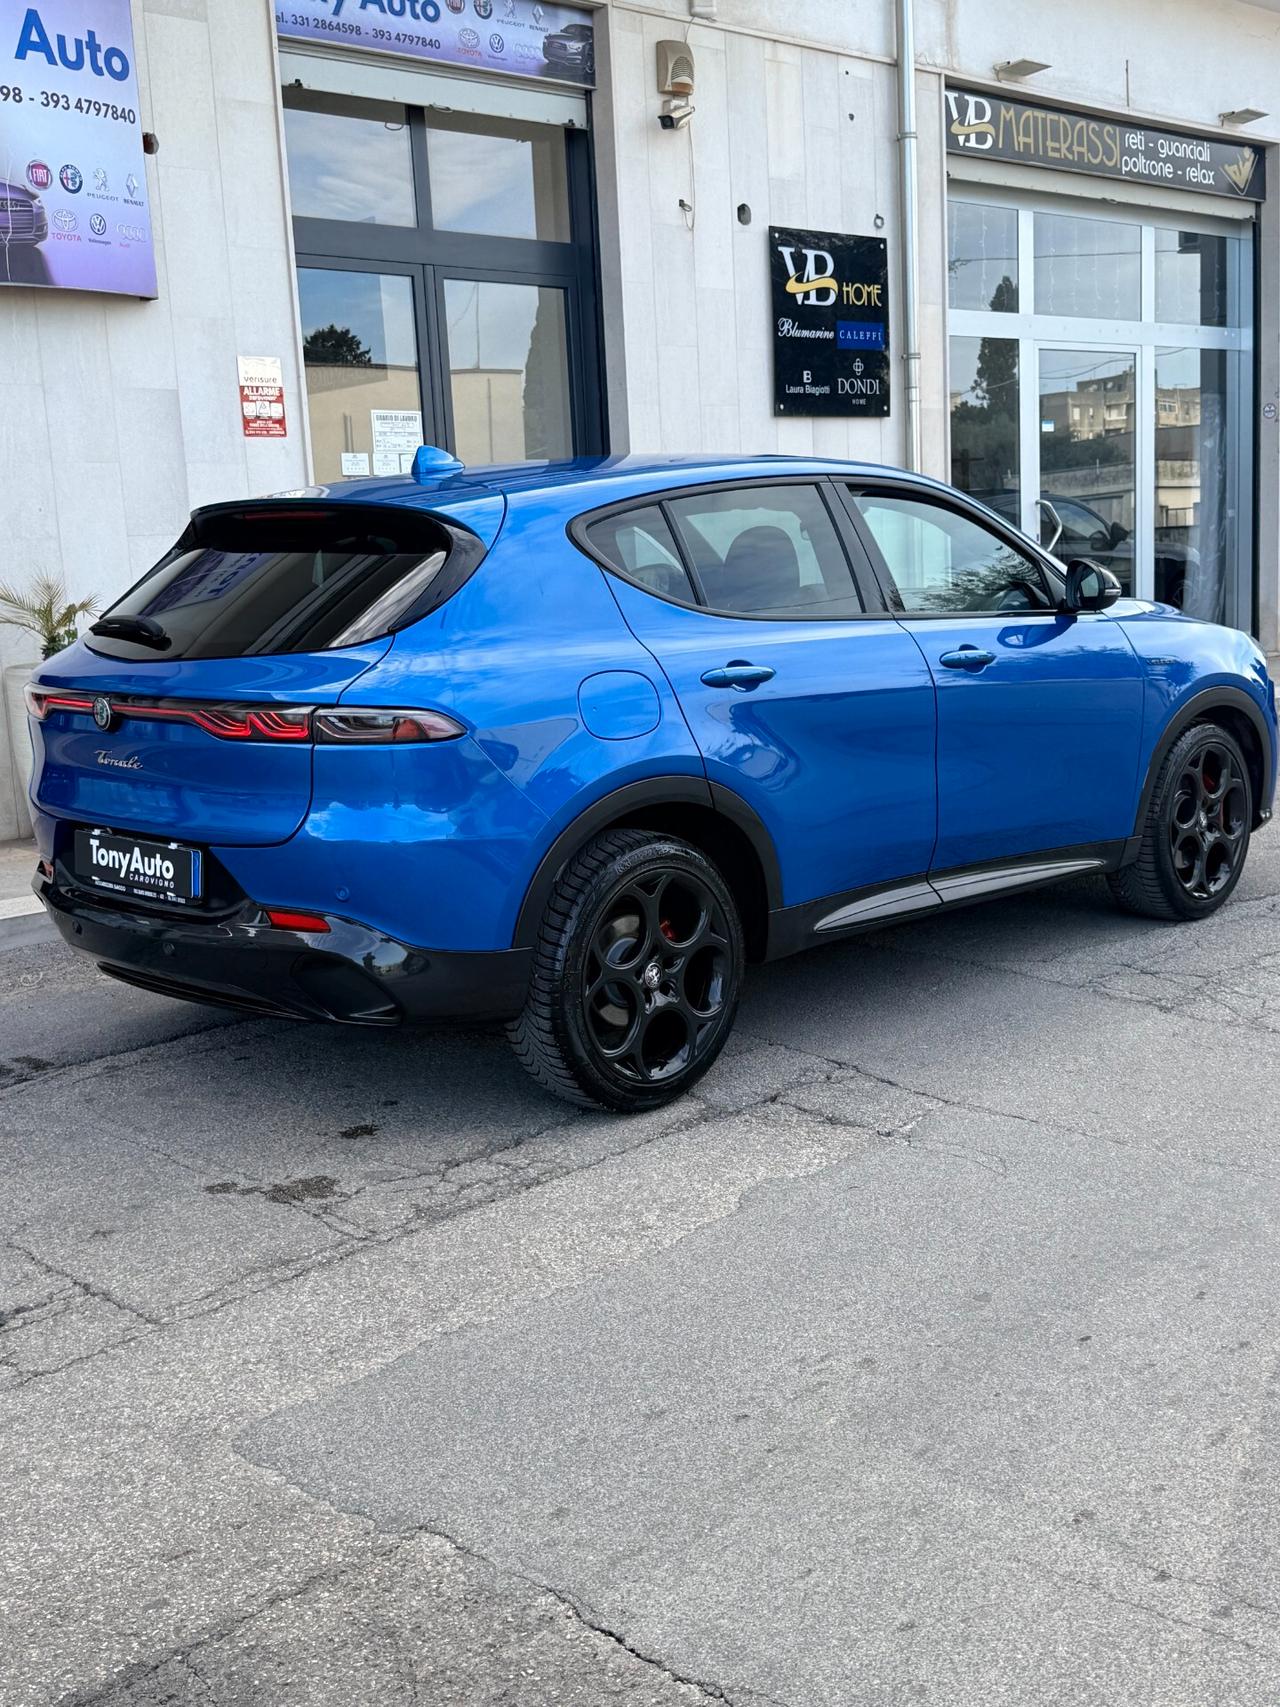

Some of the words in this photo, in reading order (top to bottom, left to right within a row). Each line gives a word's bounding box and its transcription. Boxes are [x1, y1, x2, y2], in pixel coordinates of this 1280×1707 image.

[291, 14, 311, 27] 331
[313, 18, 362, 36] 2864598
[372, 28, 392, 41] 393
[395, 32, 441, 49] 4797840
[15, 8, 130, 82] Auto
[0, 85, 23, 104] 98
[40, 91, 70, 111] 393
[74, 97, 136, 125] 4797840
[945, 91, 994, 150] VB
[999, 107, 1120, 168] MATERASSI
[1124, 131, 1145, 150] reti
[1158, 139, 1210, 163] guanciali
[32, 168, 48, 183] FIAT
[1122, 155, 1173, 184] poltrone
[1186, 162, 1215, 185] relax
[51, 232, 82, 242] TOYOTA
[778, 246, 837, 306] VB
[843, 282, 882, 307] HOME
[778, 317, 834, 340] Blumarine
[840, 329, 881, 341] CALEFFI
[803, 371, 812, 383] B
[838, 378, 880, 395] DONDI
[243, 386, 281, 397] ALLARME
[786, 384, 804, 394] Laura
[805, 384, 830, 396] Biagiotti
[90, 838, 174, 880] TonyAuto
[129, 873, 175, 889] CAROVIGNO
